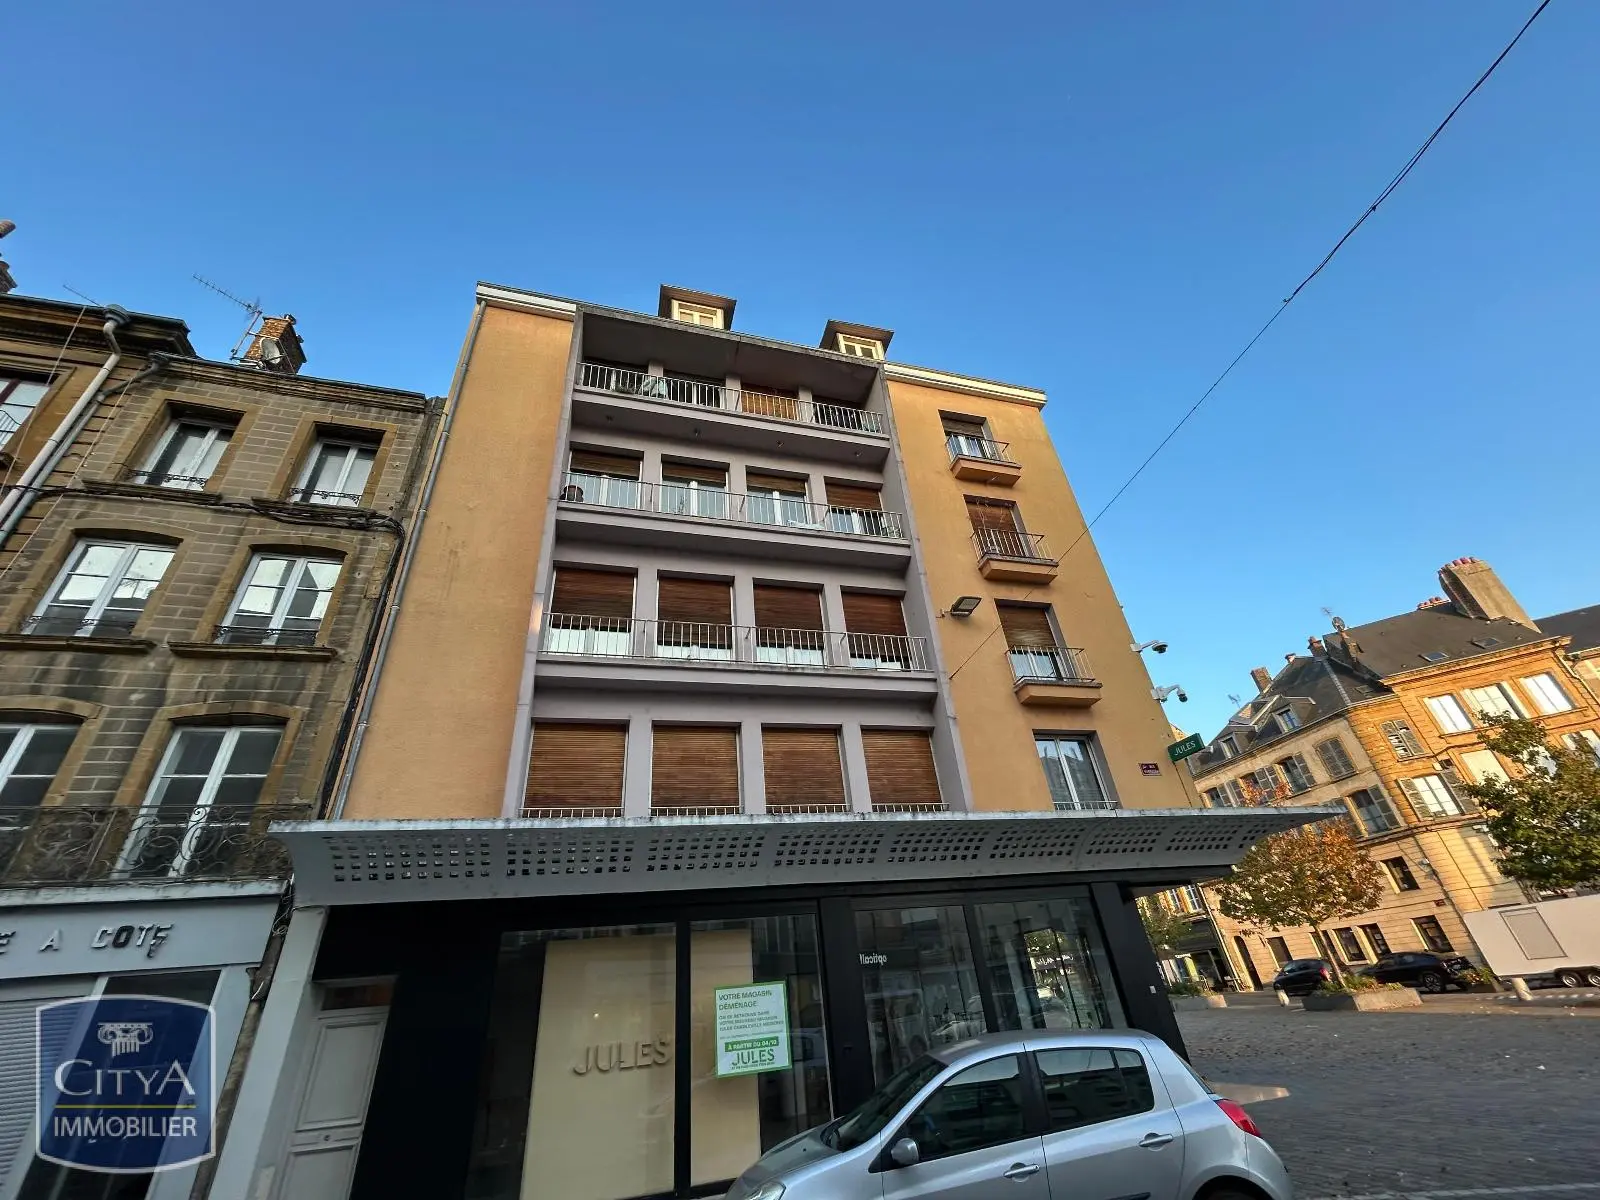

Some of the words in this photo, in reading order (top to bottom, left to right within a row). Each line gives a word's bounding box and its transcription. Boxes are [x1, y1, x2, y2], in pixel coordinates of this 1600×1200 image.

[1174, 740, 1196, 756] JULES
[38, 928, 63, 952] A
[718, 992, 741, 1001] VOTRE
[741, 990, 772, 999] MAGASIN
[573, 1039, 672, 1076] JULES
[731, 1048, 775, 1066] JULES
